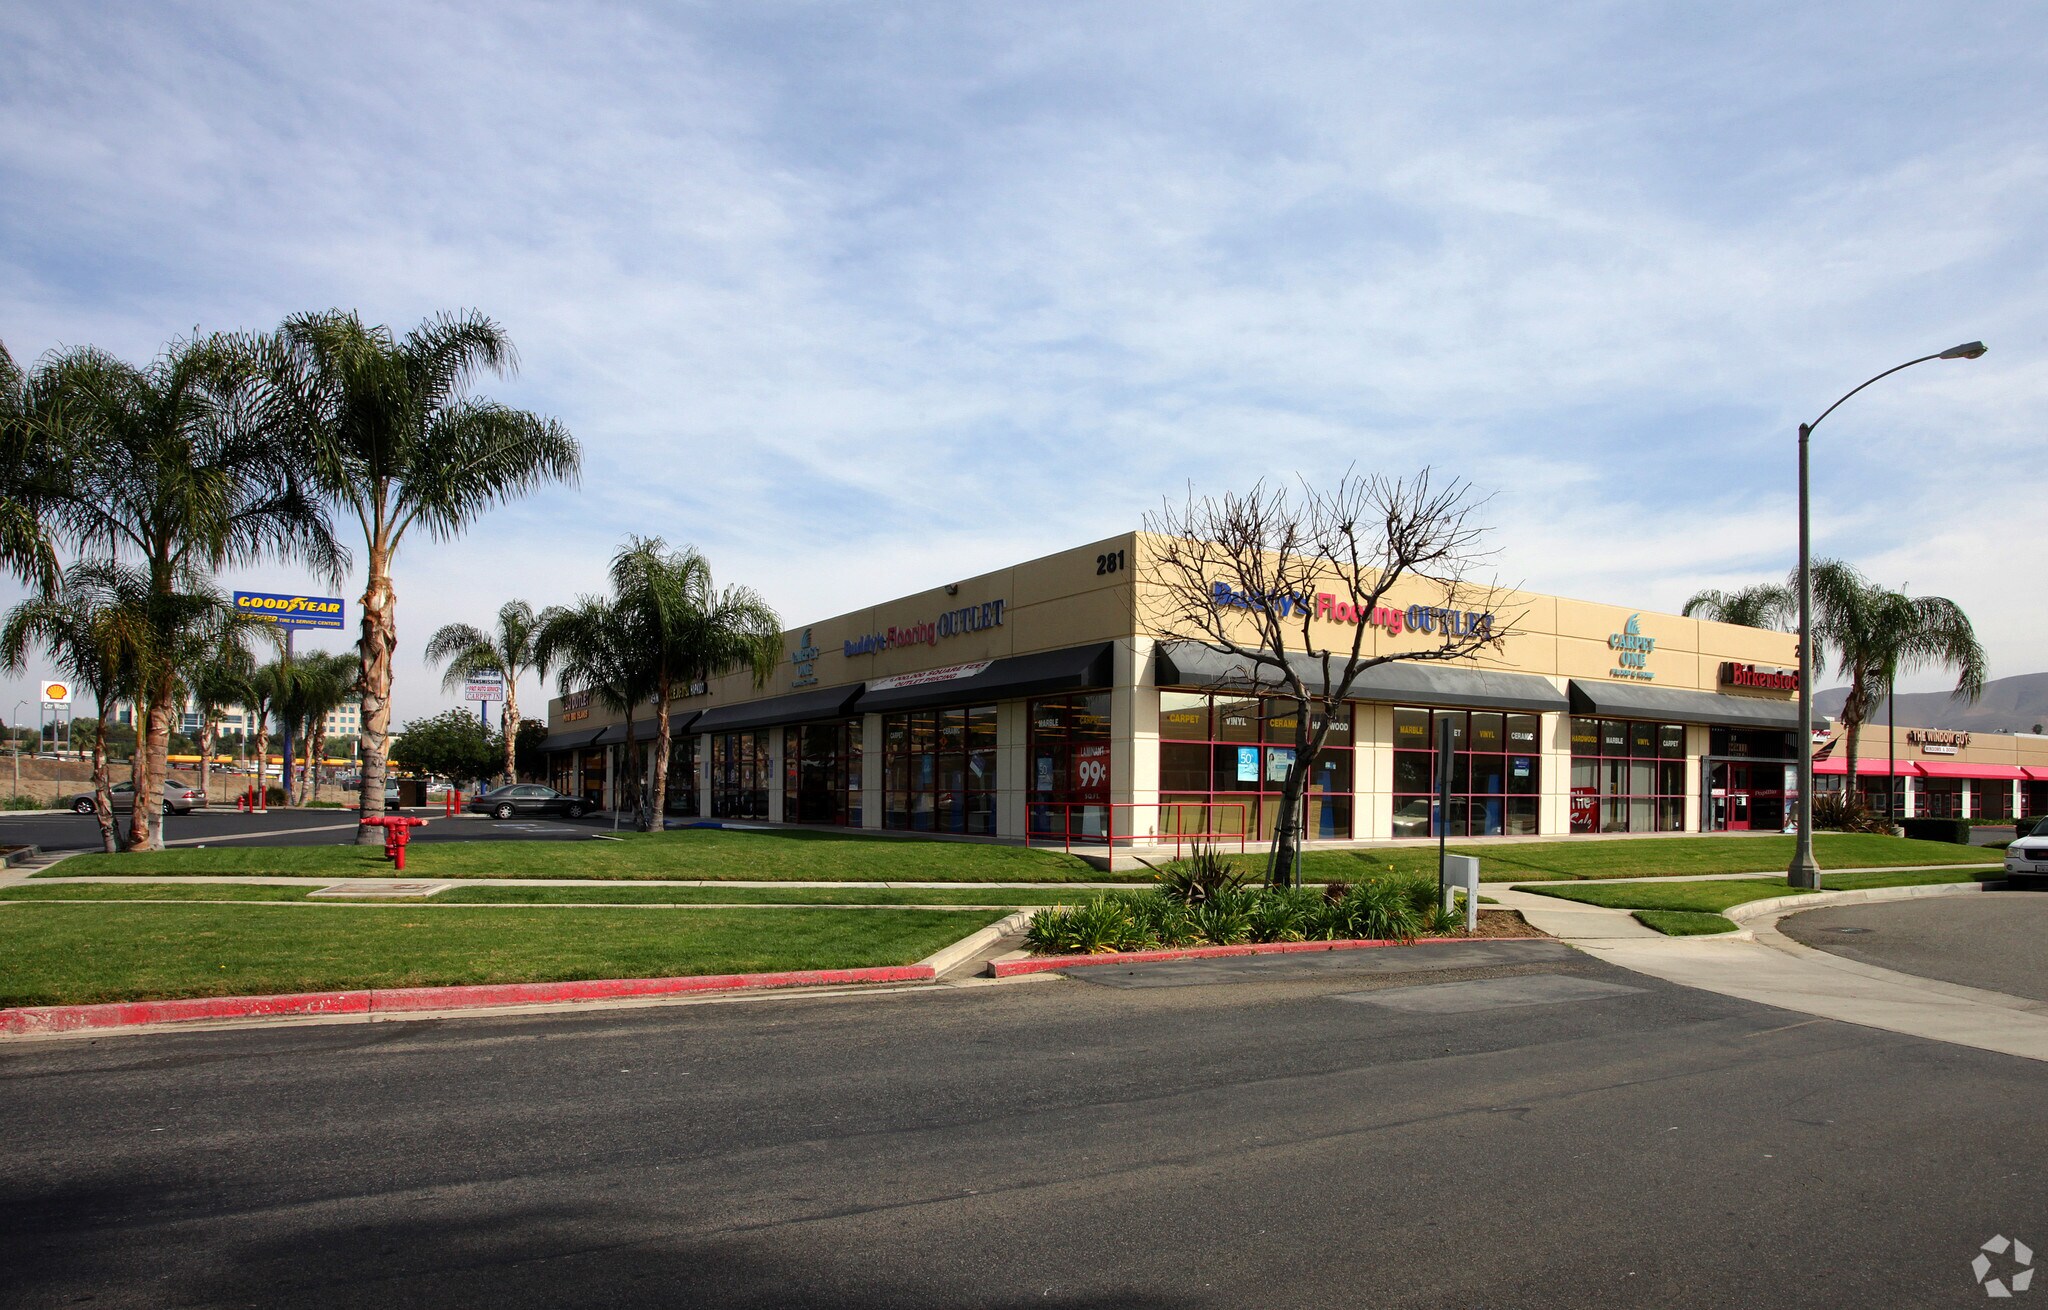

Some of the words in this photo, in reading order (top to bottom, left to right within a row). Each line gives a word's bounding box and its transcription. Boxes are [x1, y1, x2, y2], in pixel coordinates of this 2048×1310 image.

[1097, 549, 1124, 575] 281
[238, 597, 340, 613] GOODYEAR
[886, 620, 937, 646] Flooring
[939, 599, 1006, 638] OUTLET
[1609, 633, 1655, 651] CARPET
[1619, 652, 1646, 667] ONE
[923, 673, 958, 683] PRICING
[1734, 663, 1800, 690] Birkenstoc
[1169, 713, 1199, 724] CARPET
[1226, 717, 1247, 726] VINYL
[1312, 721, 1348, 731] HAWOOD
[1400, 725, 1423, 735] MARBLE
[1480, 730, 1495, 738] VINYL
[1511, 732, 1534, 740] CERAMIC
[1913, 731, 1926, 741] THE
[1927, 731, 1954, 743] WINDOW
[1240, 753, 1252, 764] 50
